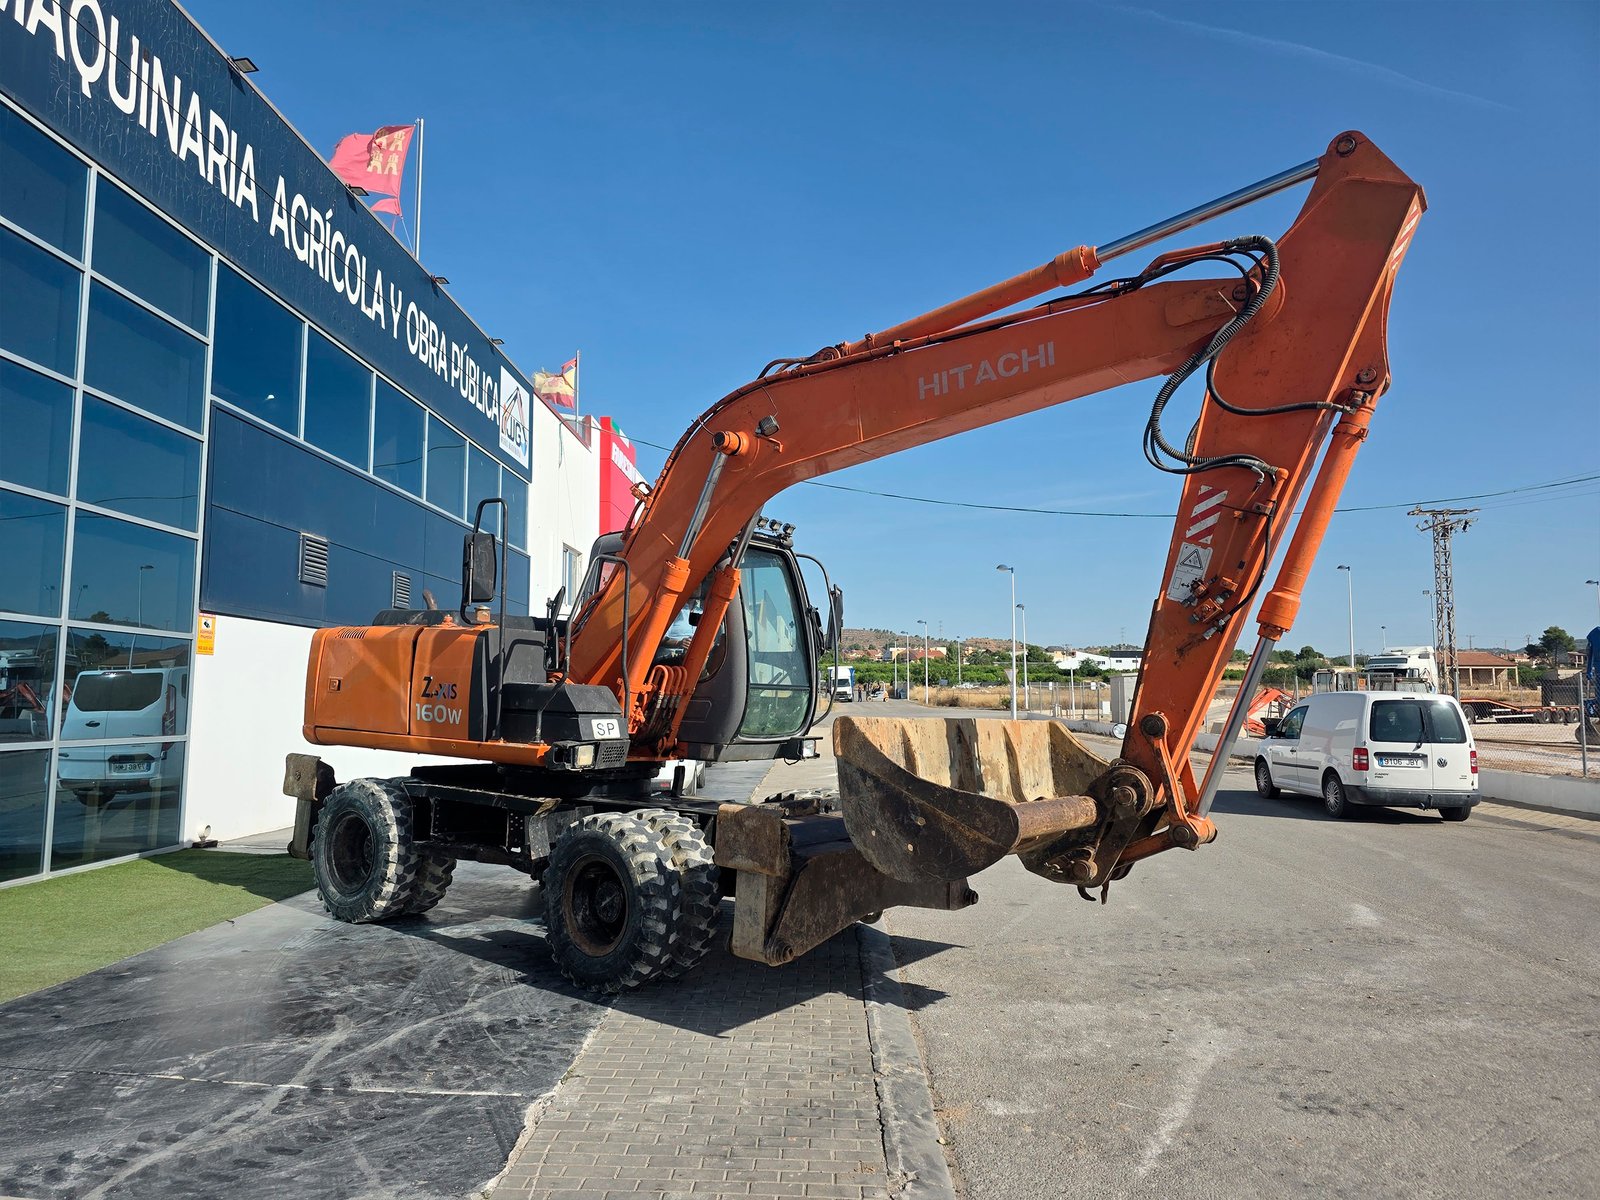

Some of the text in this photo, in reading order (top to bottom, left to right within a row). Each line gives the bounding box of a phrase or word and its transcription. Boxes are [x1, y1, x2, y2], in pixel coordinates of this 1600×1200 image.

[0, 0, 500, 426] AQUINARIA AGRÍCOLA Y OBRA PÚBLICA
[918, 341, 1056, 400] HITACHI
[415, 703, 462, 725] 160W
[596, 722, 616, 737] SP
